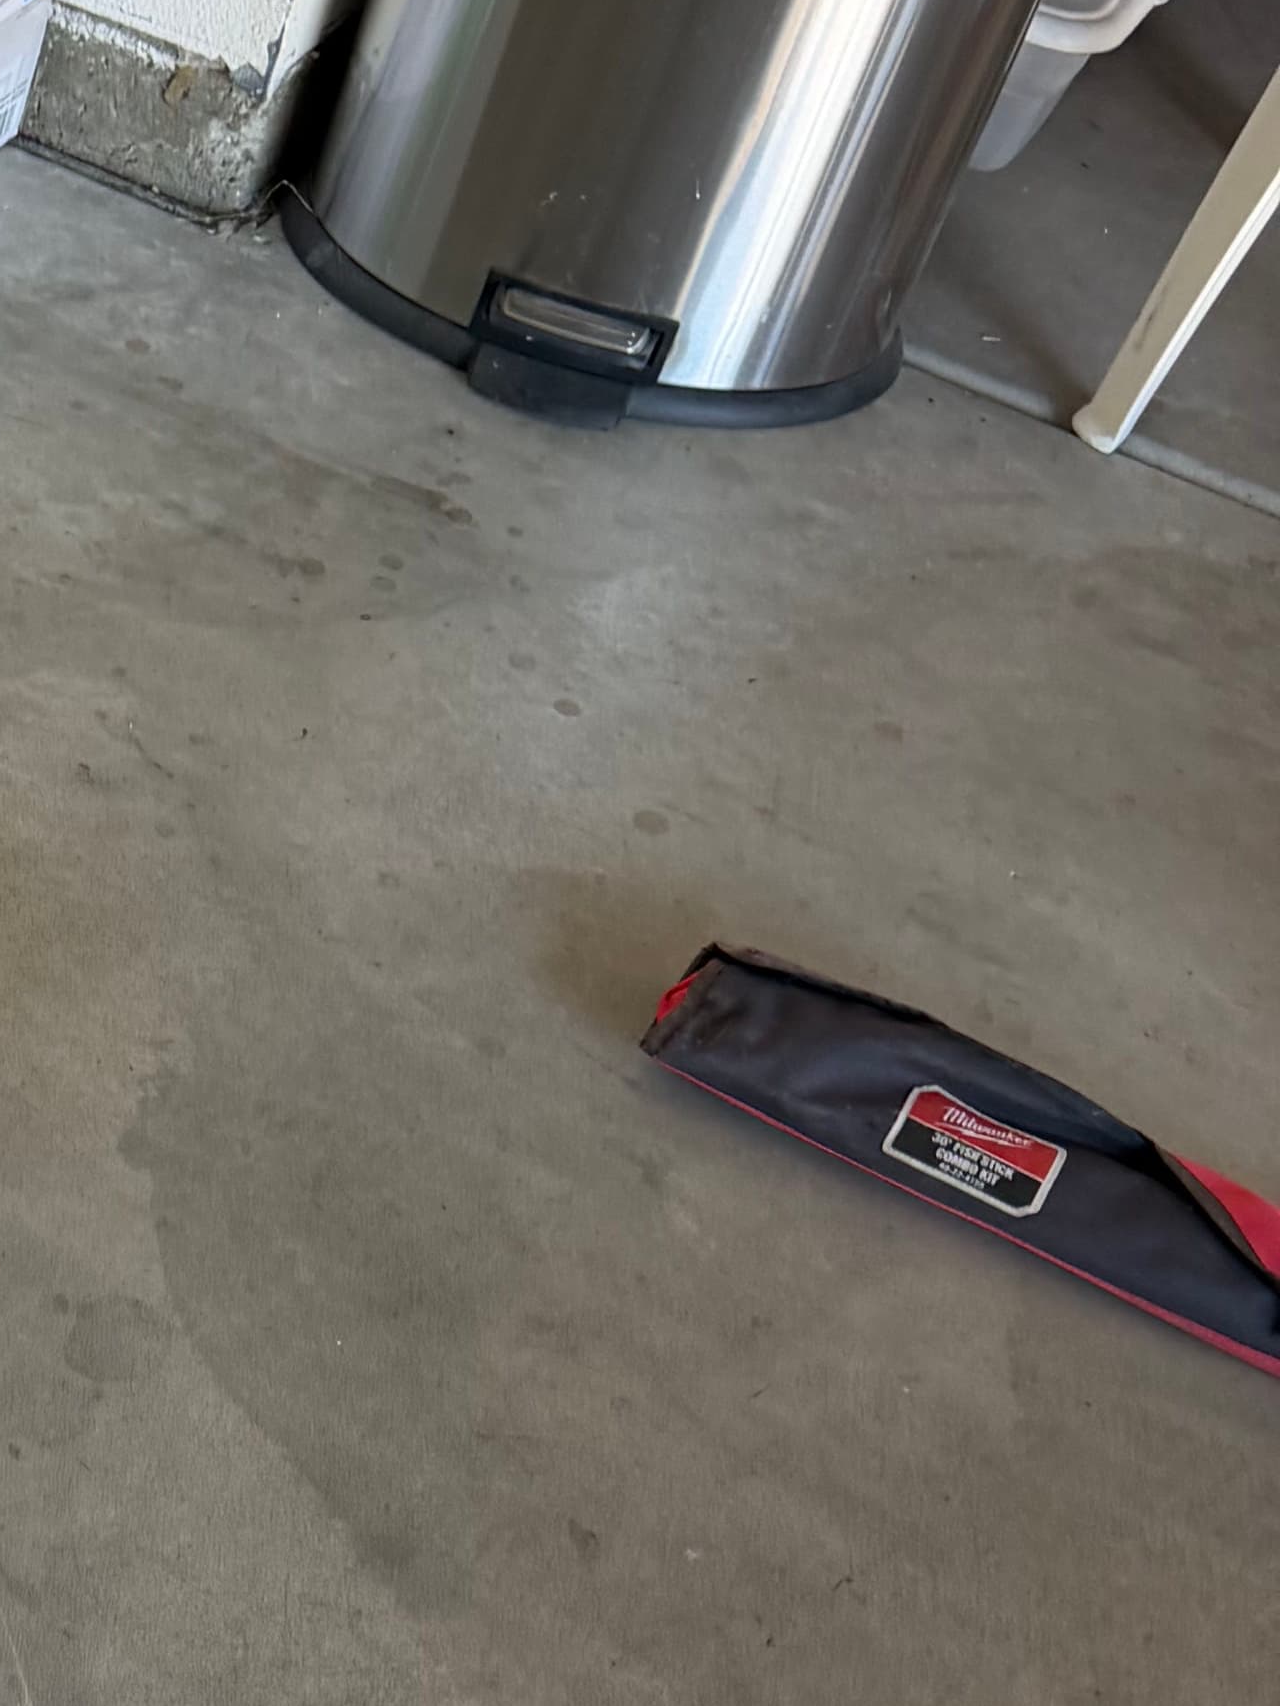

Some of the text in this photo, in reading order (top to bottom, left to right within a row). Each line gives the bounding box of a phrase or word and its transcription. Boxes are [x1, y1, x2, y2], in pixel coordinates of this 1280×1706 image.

[943, 1105, 1031, 1147] Milwaukee
[936, 1147, 1000, 1187] COMBO KIT
[953, 1141, 981, 1162] FISH
[980, 1156, 1015, 1181] STICK
